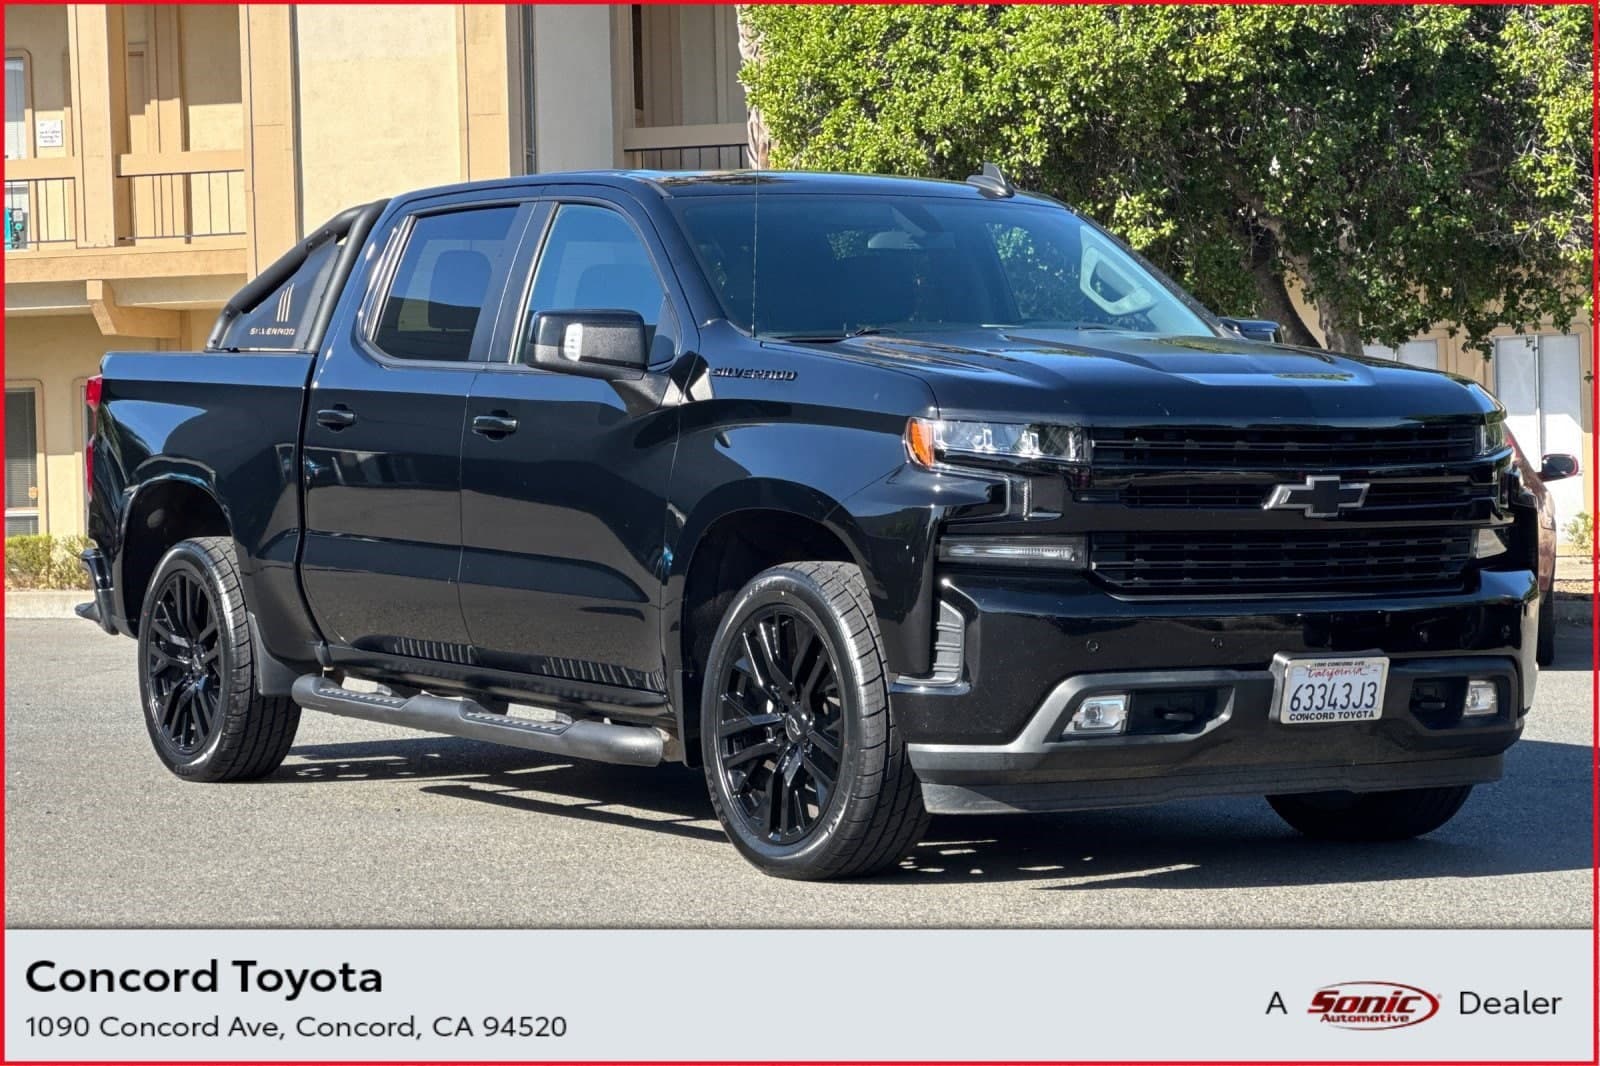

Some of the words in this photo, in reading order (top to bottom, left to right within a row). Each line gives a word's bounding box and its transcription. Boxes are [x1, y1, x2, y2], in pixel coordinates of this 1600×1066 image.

[711, 367, 799, 382] SILVERADO
[1306, 665, 1369, 681] California
[1290, 682, 1377, 711] 63343J3
[1289, 711, 1335, 721] CONCORD
[1338, 710, 1375, 720] TOYOTA
